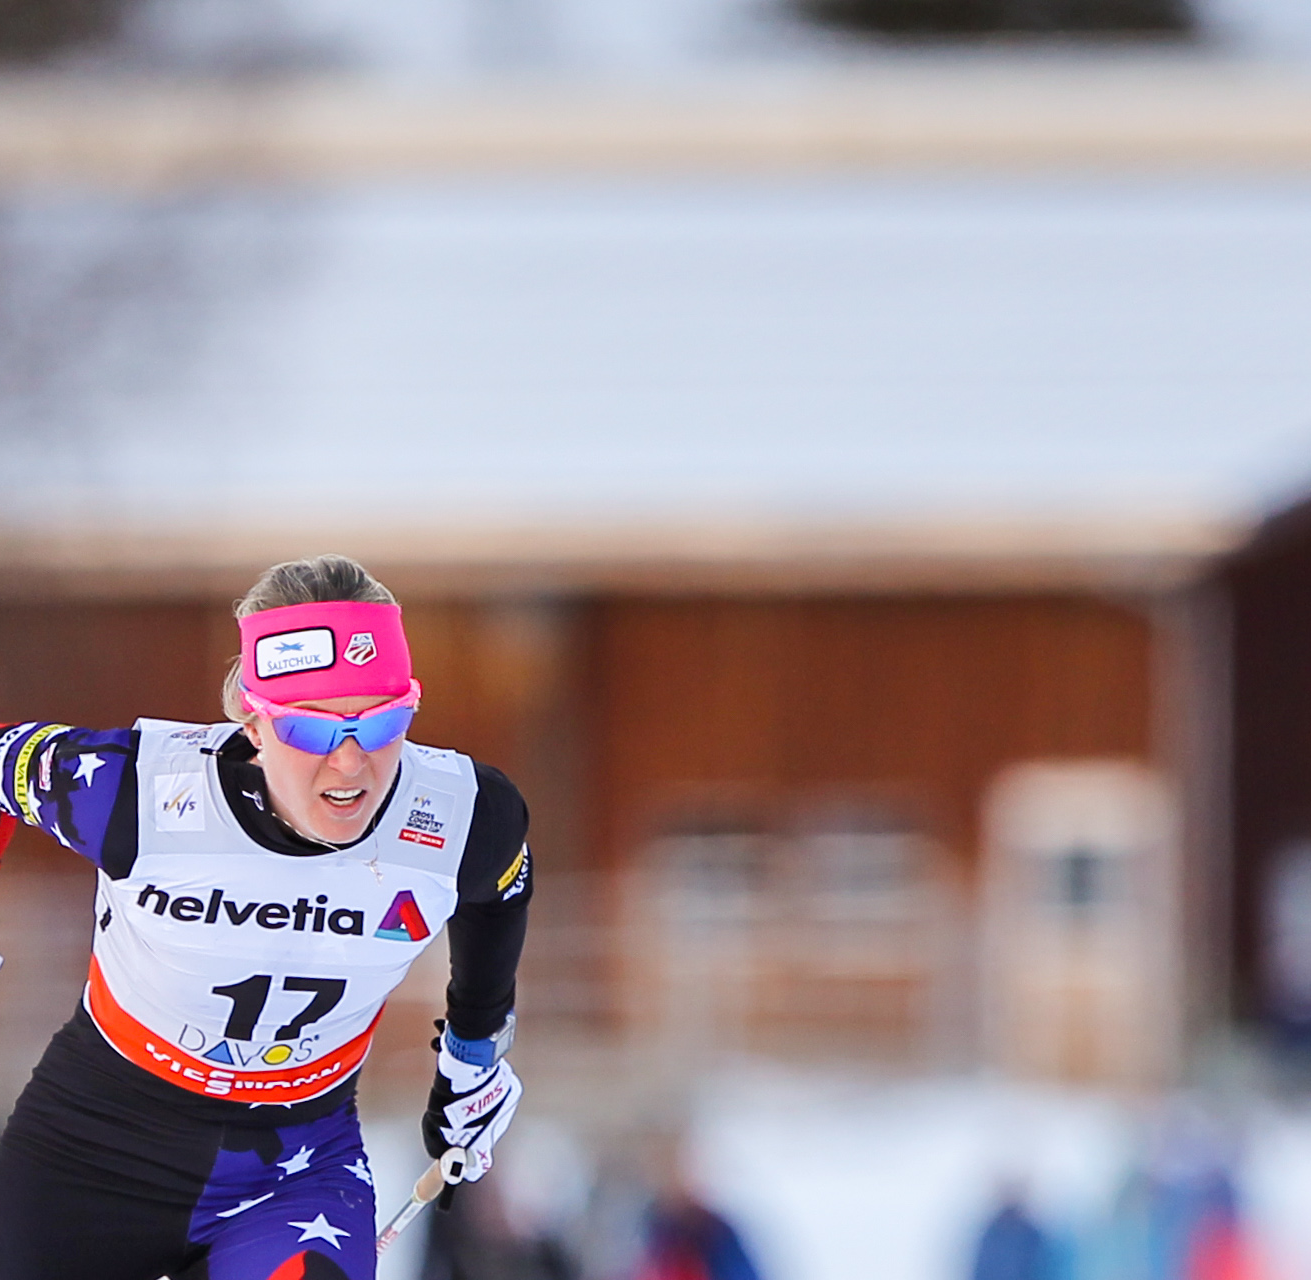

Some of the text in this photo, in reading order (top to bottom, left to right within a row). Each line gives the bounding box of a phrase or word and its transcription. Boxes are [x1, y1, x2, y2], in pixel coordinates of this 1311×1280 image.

[267, 654, 321, 672] SALTCHUK
[136, 884, 364, 936] helvetia
[212, 974, 347, 1041] 17
